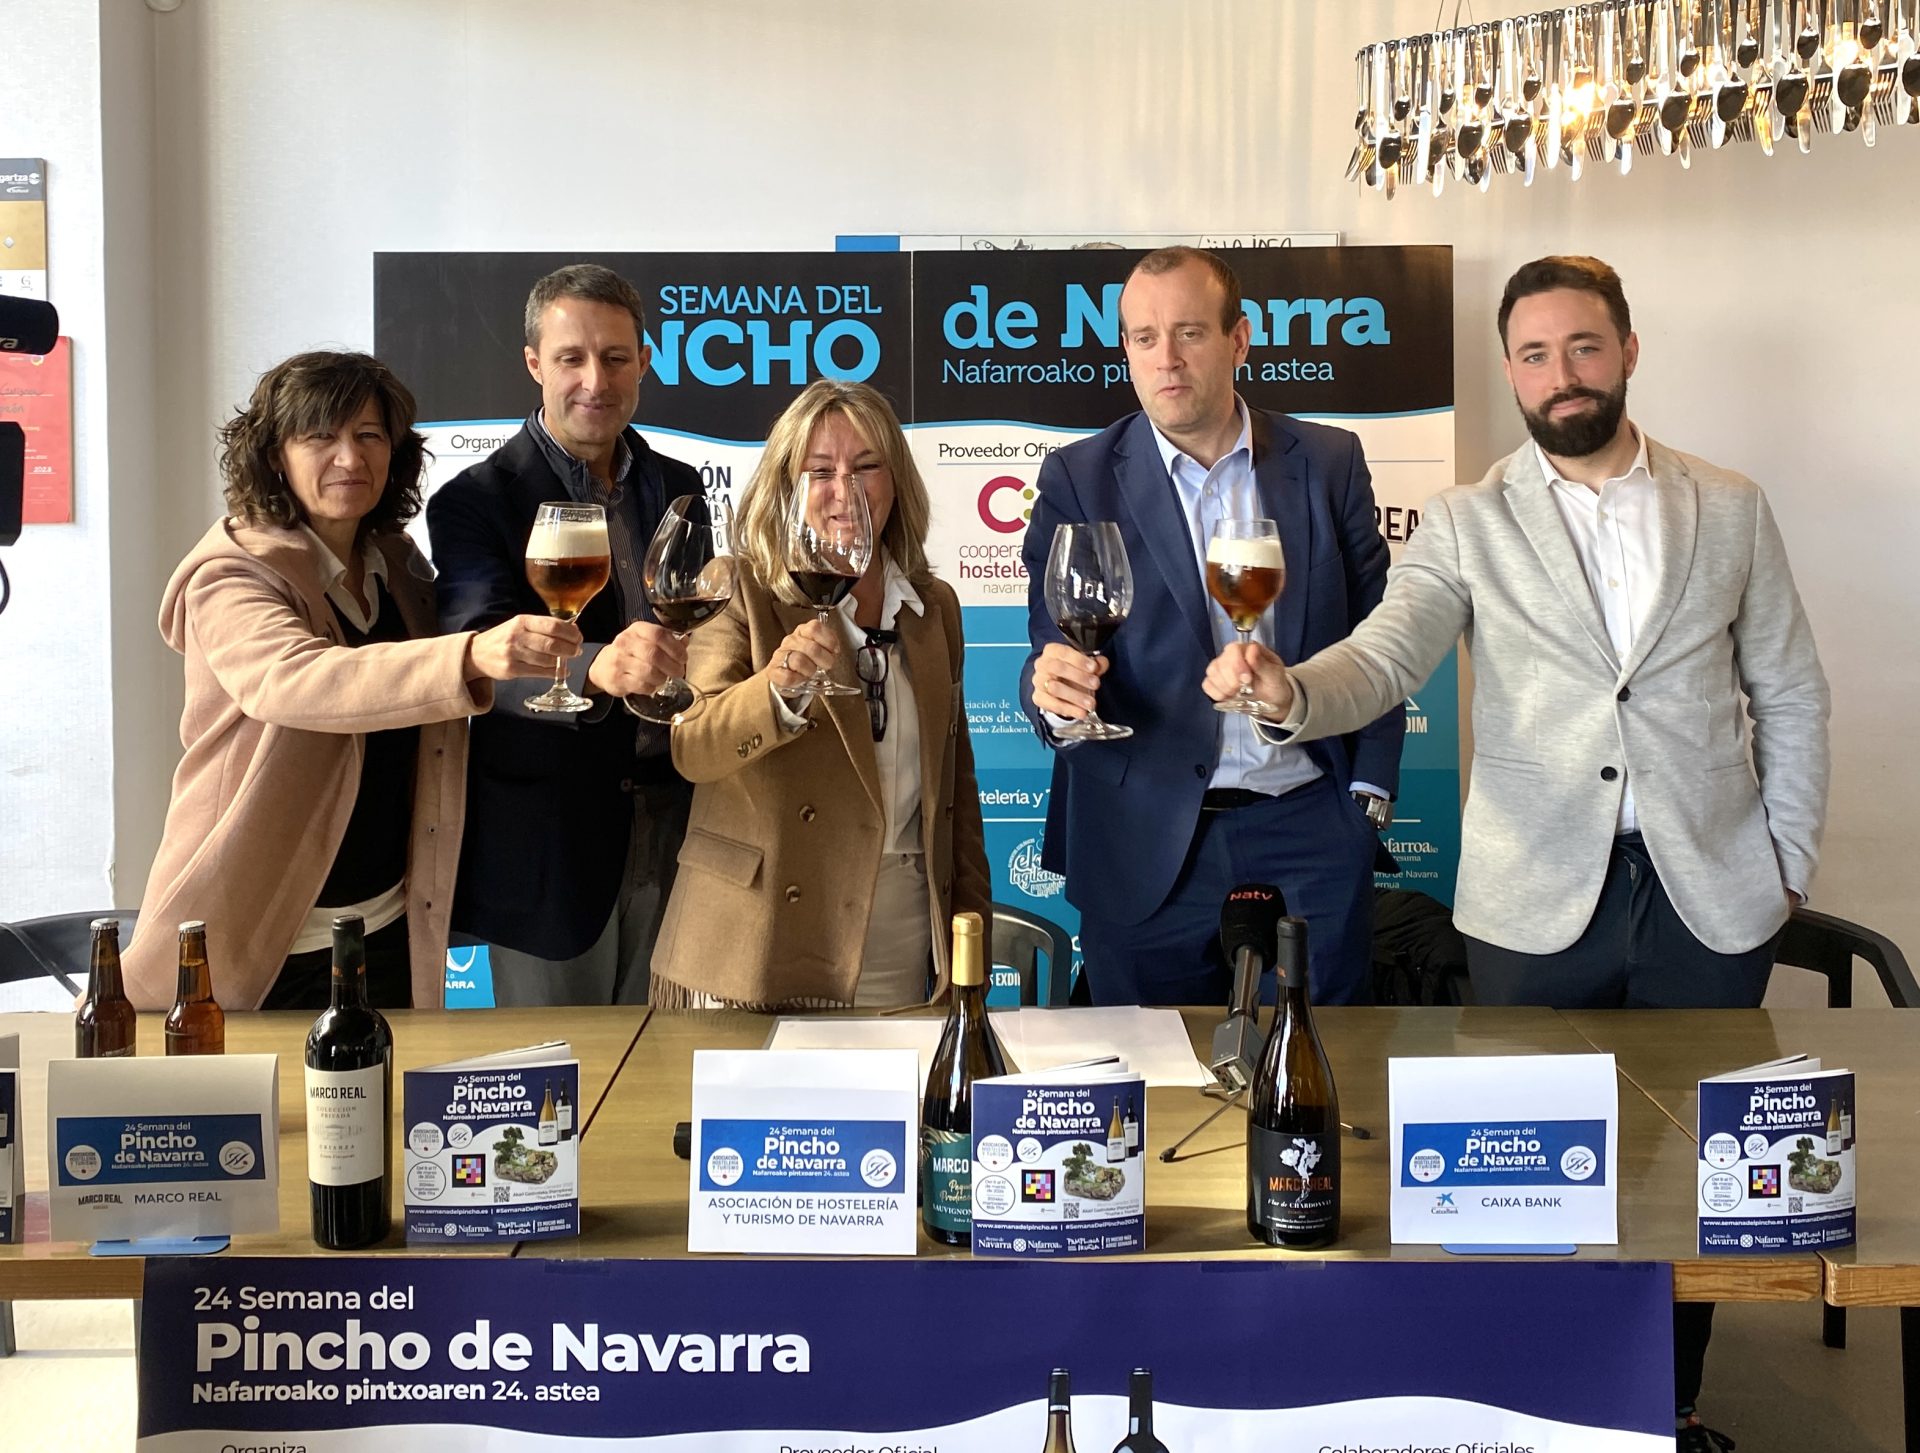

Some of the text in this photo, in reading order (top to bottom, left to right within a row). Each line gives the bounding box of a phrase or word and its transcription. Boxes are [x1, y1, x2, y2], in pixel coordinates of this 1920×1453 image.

[659, 285, 882, 314] SEMANA DEL
[942, 283, 1391, 349] de Narra
[643, 319, 881, 387] NCHO
[942, 358, 1095, 384] Nafarroako
[1261, 361, 1334, 383] astea
[451, 434, 511, 453] Organi
[938, 442, 1021, 458] Proveedor
[959, 545, 1024, 563] coopera
[960, 560, 1028, 579] hostele
[965, 699, 1010, 709] ciación de
[967, 711, 993, 723] acos
[997, 711, 1011, 723] de
[1406, 716, 1428, 734] DIM
[979, 789, 1043, 808] telería y
[1406, 870, 1439, 879] Navarra
[445, 980, 476, 989] ARRA
[995, 972, 1021, 987] EXDI
[458, 1072, 521, 1084] 24 Semana del
[310, 1086, 366, 1099] MARCO REAL
[453, 1082, 527, 1100] Pincho
[1027, 1089, 1090, 1098] 24 Semana del
[1754, 1083, 1812, 1094] 24 Semana del
[446, 1100, 532, 1114] de Navarra
[1023, 1098, 1095, 1115] Pincho
[1750, 1093, 1816, 1111] Pincho
[1015, 1115, 1100, 1129] de Navarra
[1743, 1110, 1821, 1125] de Navarra
[137, 1123, 174, 1131] Semana
[176, 1122, 191, 1130] del
[769, 1126, 835, 1136] 24 Semana del
[1471, 1127, 1536, 1137] 24 Semana del
[120, 1132, 196, 1149] Pincho
[764, 1136, 840, 1155] Pincho
[1466, 1136, 1541, 1154] Pincho
[114, 1149, 205, 1164] de Navarra
[756, 1155, 846, 1170] de Navarra
[1458, 1154, 1546, 1167] de Navarra
[932, 1157, 969, 1174] MARCO
[134, 1191, 222, 1204] MARCO REAL
[708, 1196, 898, 1210] ASOCIACIÓN DE HOSTELERÍA
[1481, 1197, 1562, 1208] CAIXA BANK
[723, 1214, 884, 1226] Y TURISMO DE NAVARRA
[410, 1225, 443, 1234] Navarra
[978, 1239, 1012, 1249] Navarra
[1705, 1236, 1738, 1246] Navarra
[194, 1285, 414, 1311] 24 Semana del
[196, 1315, 810, 1373] Pincho de Navarra
[193, 1378, 600, 1405] Nafarroako pintxoaren 24. astea
